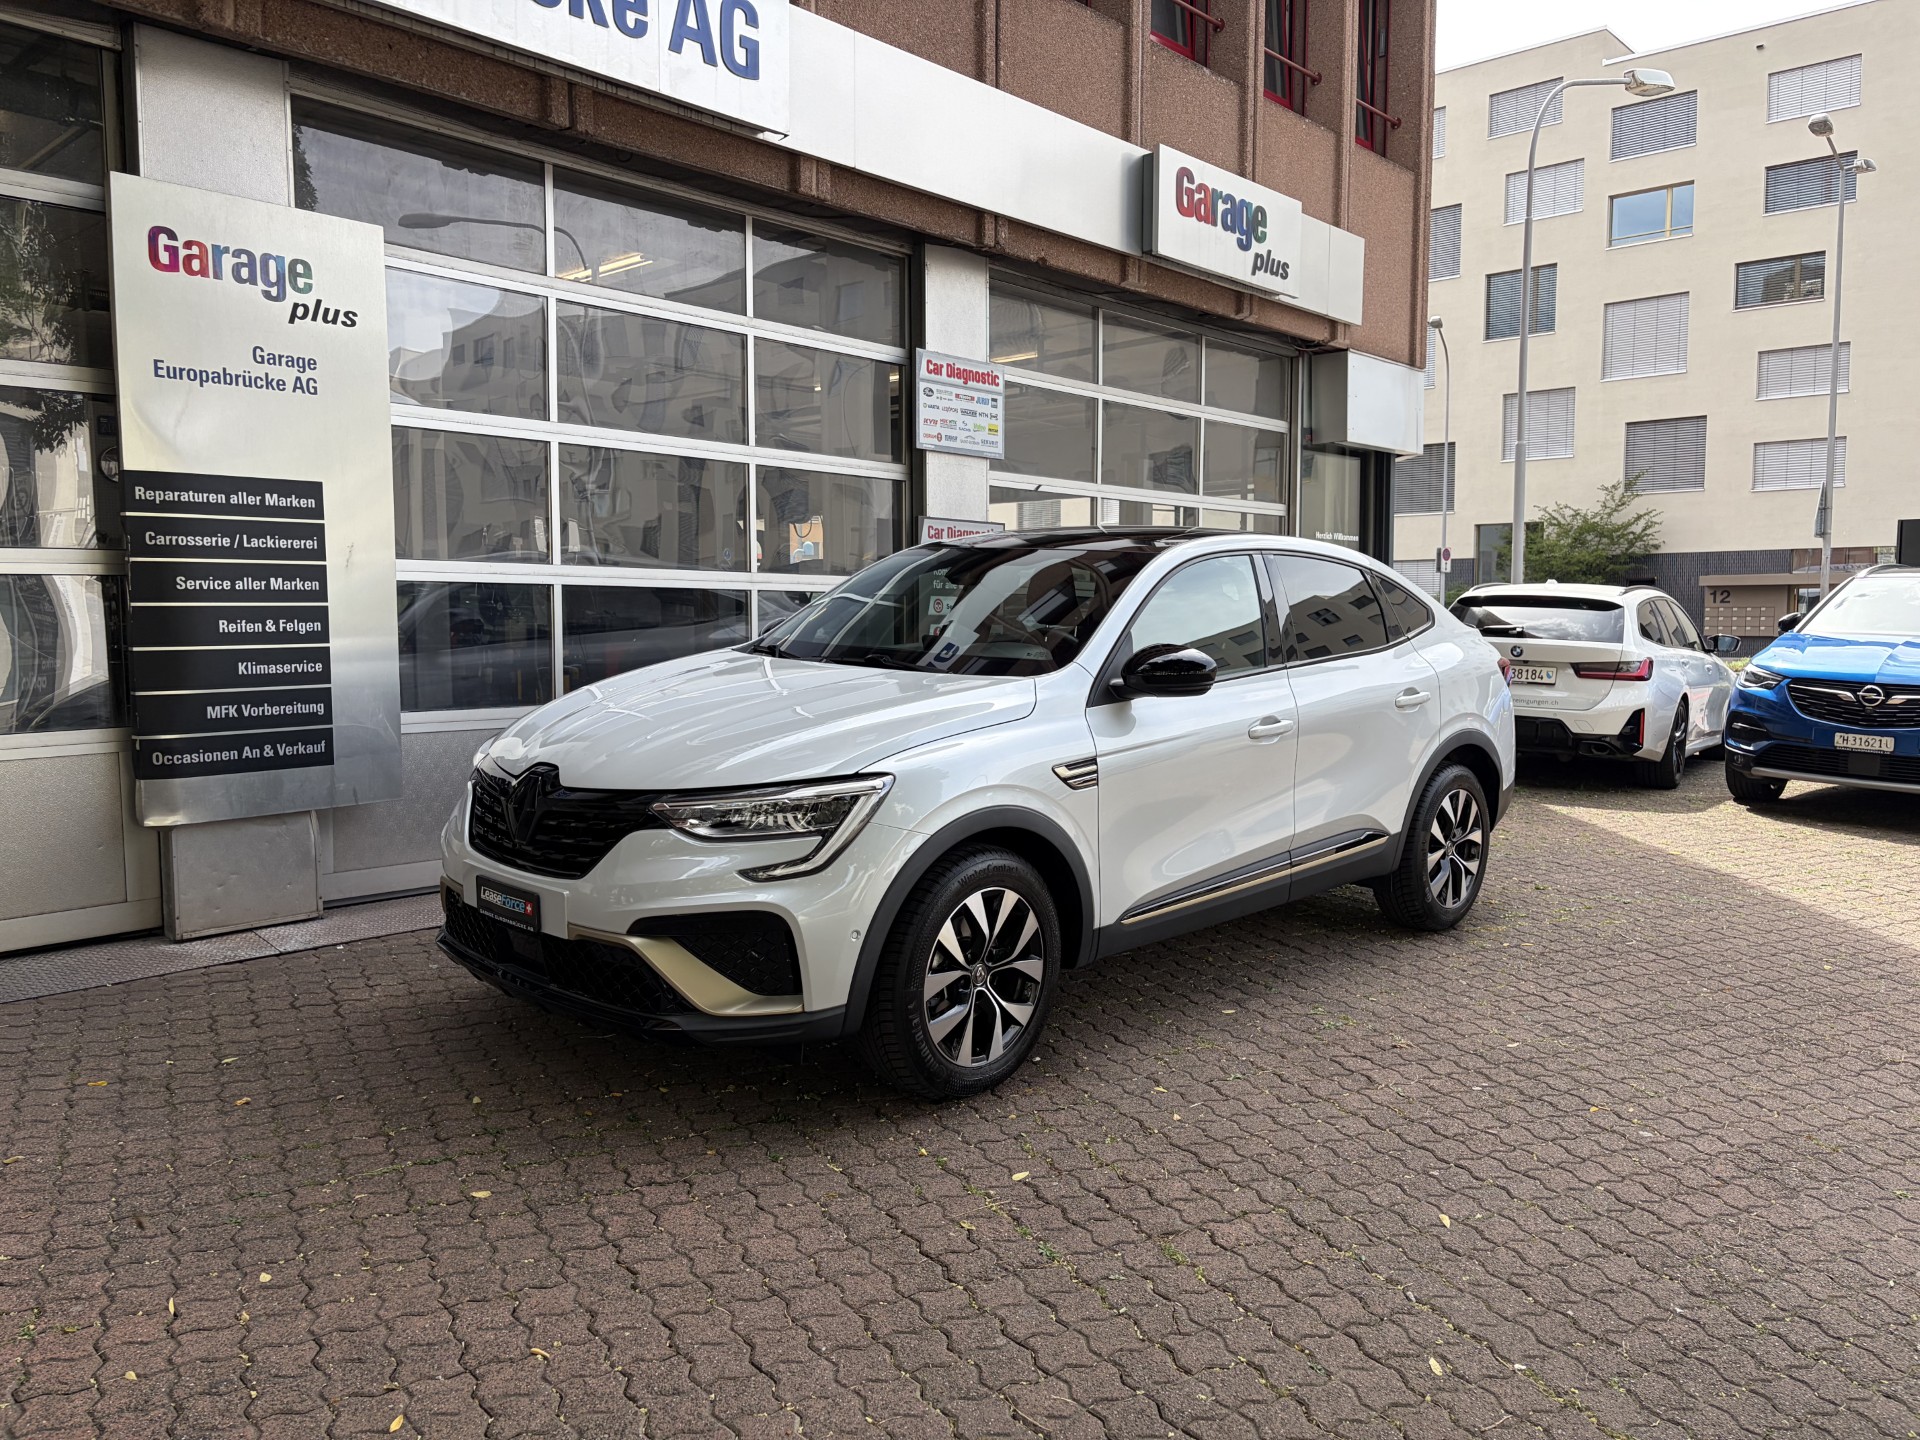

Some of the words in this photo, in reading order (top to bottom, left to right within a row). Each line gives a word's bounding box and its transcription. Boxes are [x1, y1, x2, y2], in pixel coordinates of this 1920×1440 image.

[668, 0, 760, 80] AG
[1175, 166, 1268, 251] Garage
[147, 225, 314, 302] Garage
[1251, 249, 1290, 280] plus
[288, 298, 359, 328] plus
[252, 345, 318, 373] Garage
[153, 358, 287, 392] Europabrücke
[292, 376, 319, 396] AG
[926, 359, 944, 376] Car
[946, 362, 1000, 387] Diagnostic
[134, 486, 226, 505] Reparaturen
[229, 491, 262, 506] aller
[265, 494, 315, 508] Marken
[145, 531, 231, 548] Carrosserie
[243, 535, 318, 550] Lackiererei
[927, 525, 945, 540] Car
[1315, 531, 1332, 539] Herzlich
[1333, 533, 1359, 541] Willkommen
[176, 576, 231, 591] Service
[235, 577, 267, 591] aller
[269, 577, 320, 591] Marken
[1709, 589, 1731, 604] 12
[218, 619, 262, 633] Reifen
[265, 619, 276, 633] &
[279, 618, 322, 634] Felgen
[238, 660, 323, 675] Klimaservice
[206, 705, 239, 719] MFK
[241, 701, 325, 717] Vorbereitung
[152, 750, 238, 766] Occasionen
[242, 747, 260, 760] An
[263, 745, 275, 758] &
[277, 740, 326, 756] Verkauf
[957, 863, 1019, 887] WinterContact
[481, 886, 526, 912] LeaseForce
